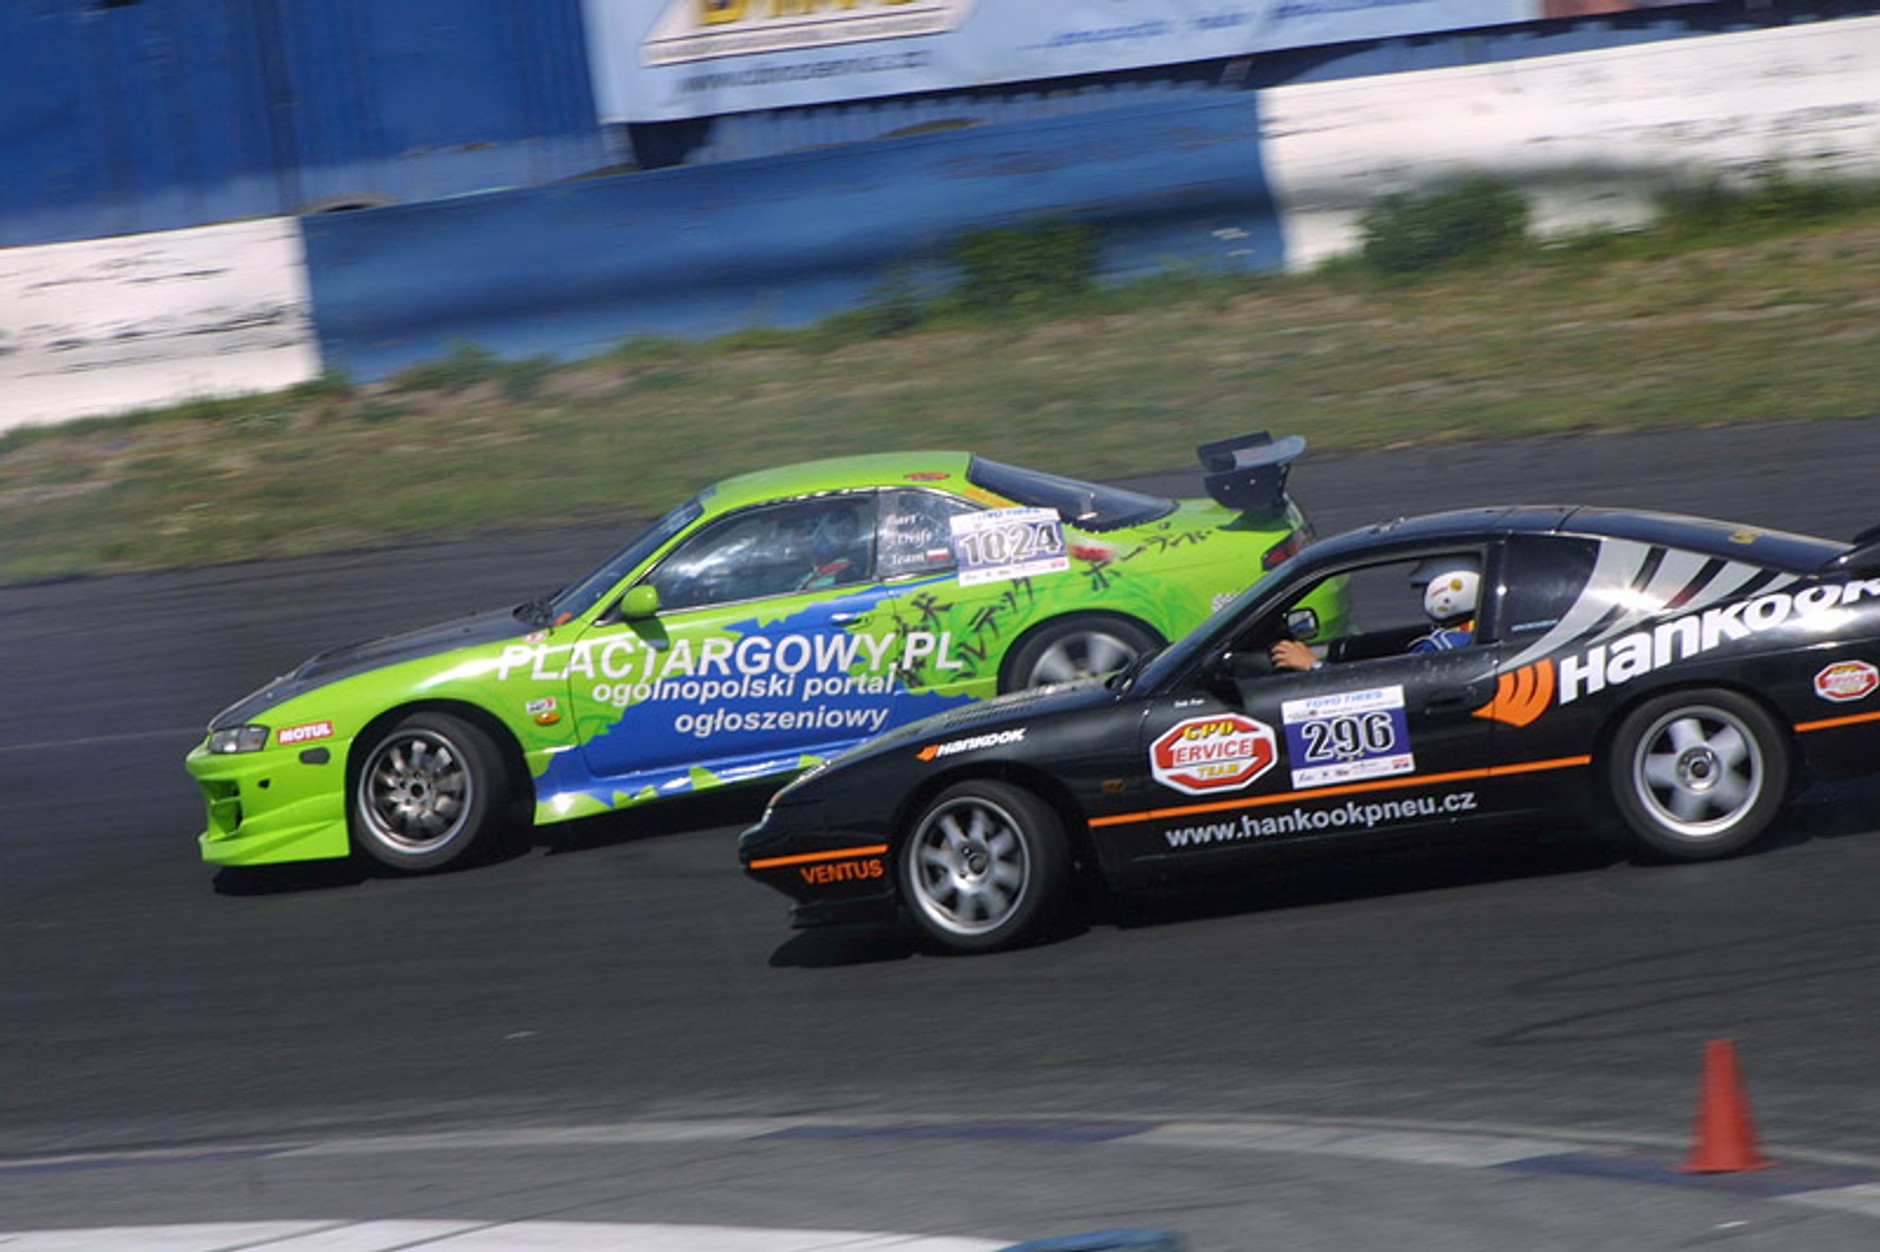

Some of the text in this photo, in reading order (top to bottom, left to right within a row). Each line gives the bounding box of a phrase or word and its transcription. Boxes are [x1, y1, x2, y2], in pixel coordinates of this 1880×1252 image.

[960, 522, 1062, 566] 1024
[804, 670, 897, 698] portal
[279, 723, 331, 742] MOTUL
[674, 706, 888, 738] ogłoszeniowy
[1302, 712, 1395, 761] 296
[1165, 791, 1476, 848] www.hankookpneu.cz
[800, 859, 884, 884] VENTUS
